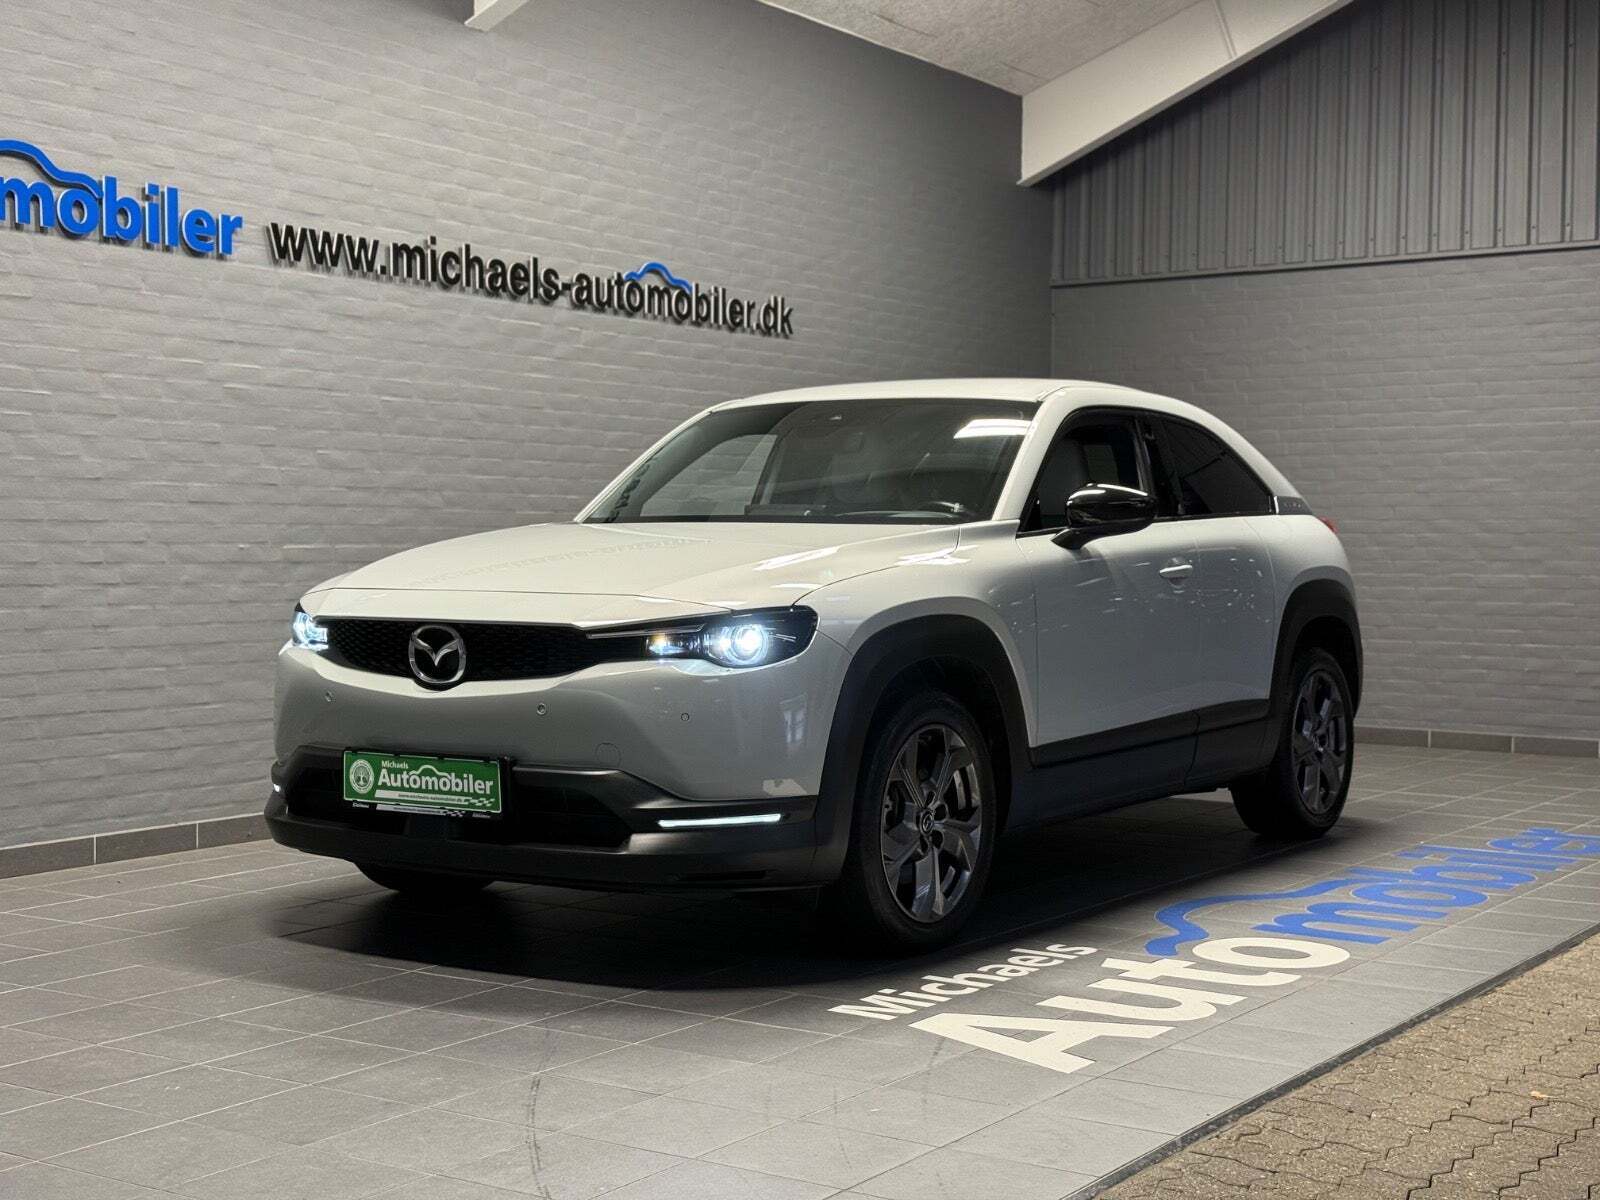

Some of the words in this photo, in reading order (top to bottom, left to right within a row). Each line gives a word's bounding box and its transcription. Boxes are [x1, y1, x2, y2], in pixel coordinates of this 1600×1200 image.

[0, 175, 243, 255] mobiler
[268, 221, 793, 335] www.michaels-automobiler.dk
[378, 768, 494, 795] Automobiler
[381, 760, 409, 770] Michaels
[827, 943, 1099, 1021] Michaels
[908, 827, 1600, 1074] Automobiler
